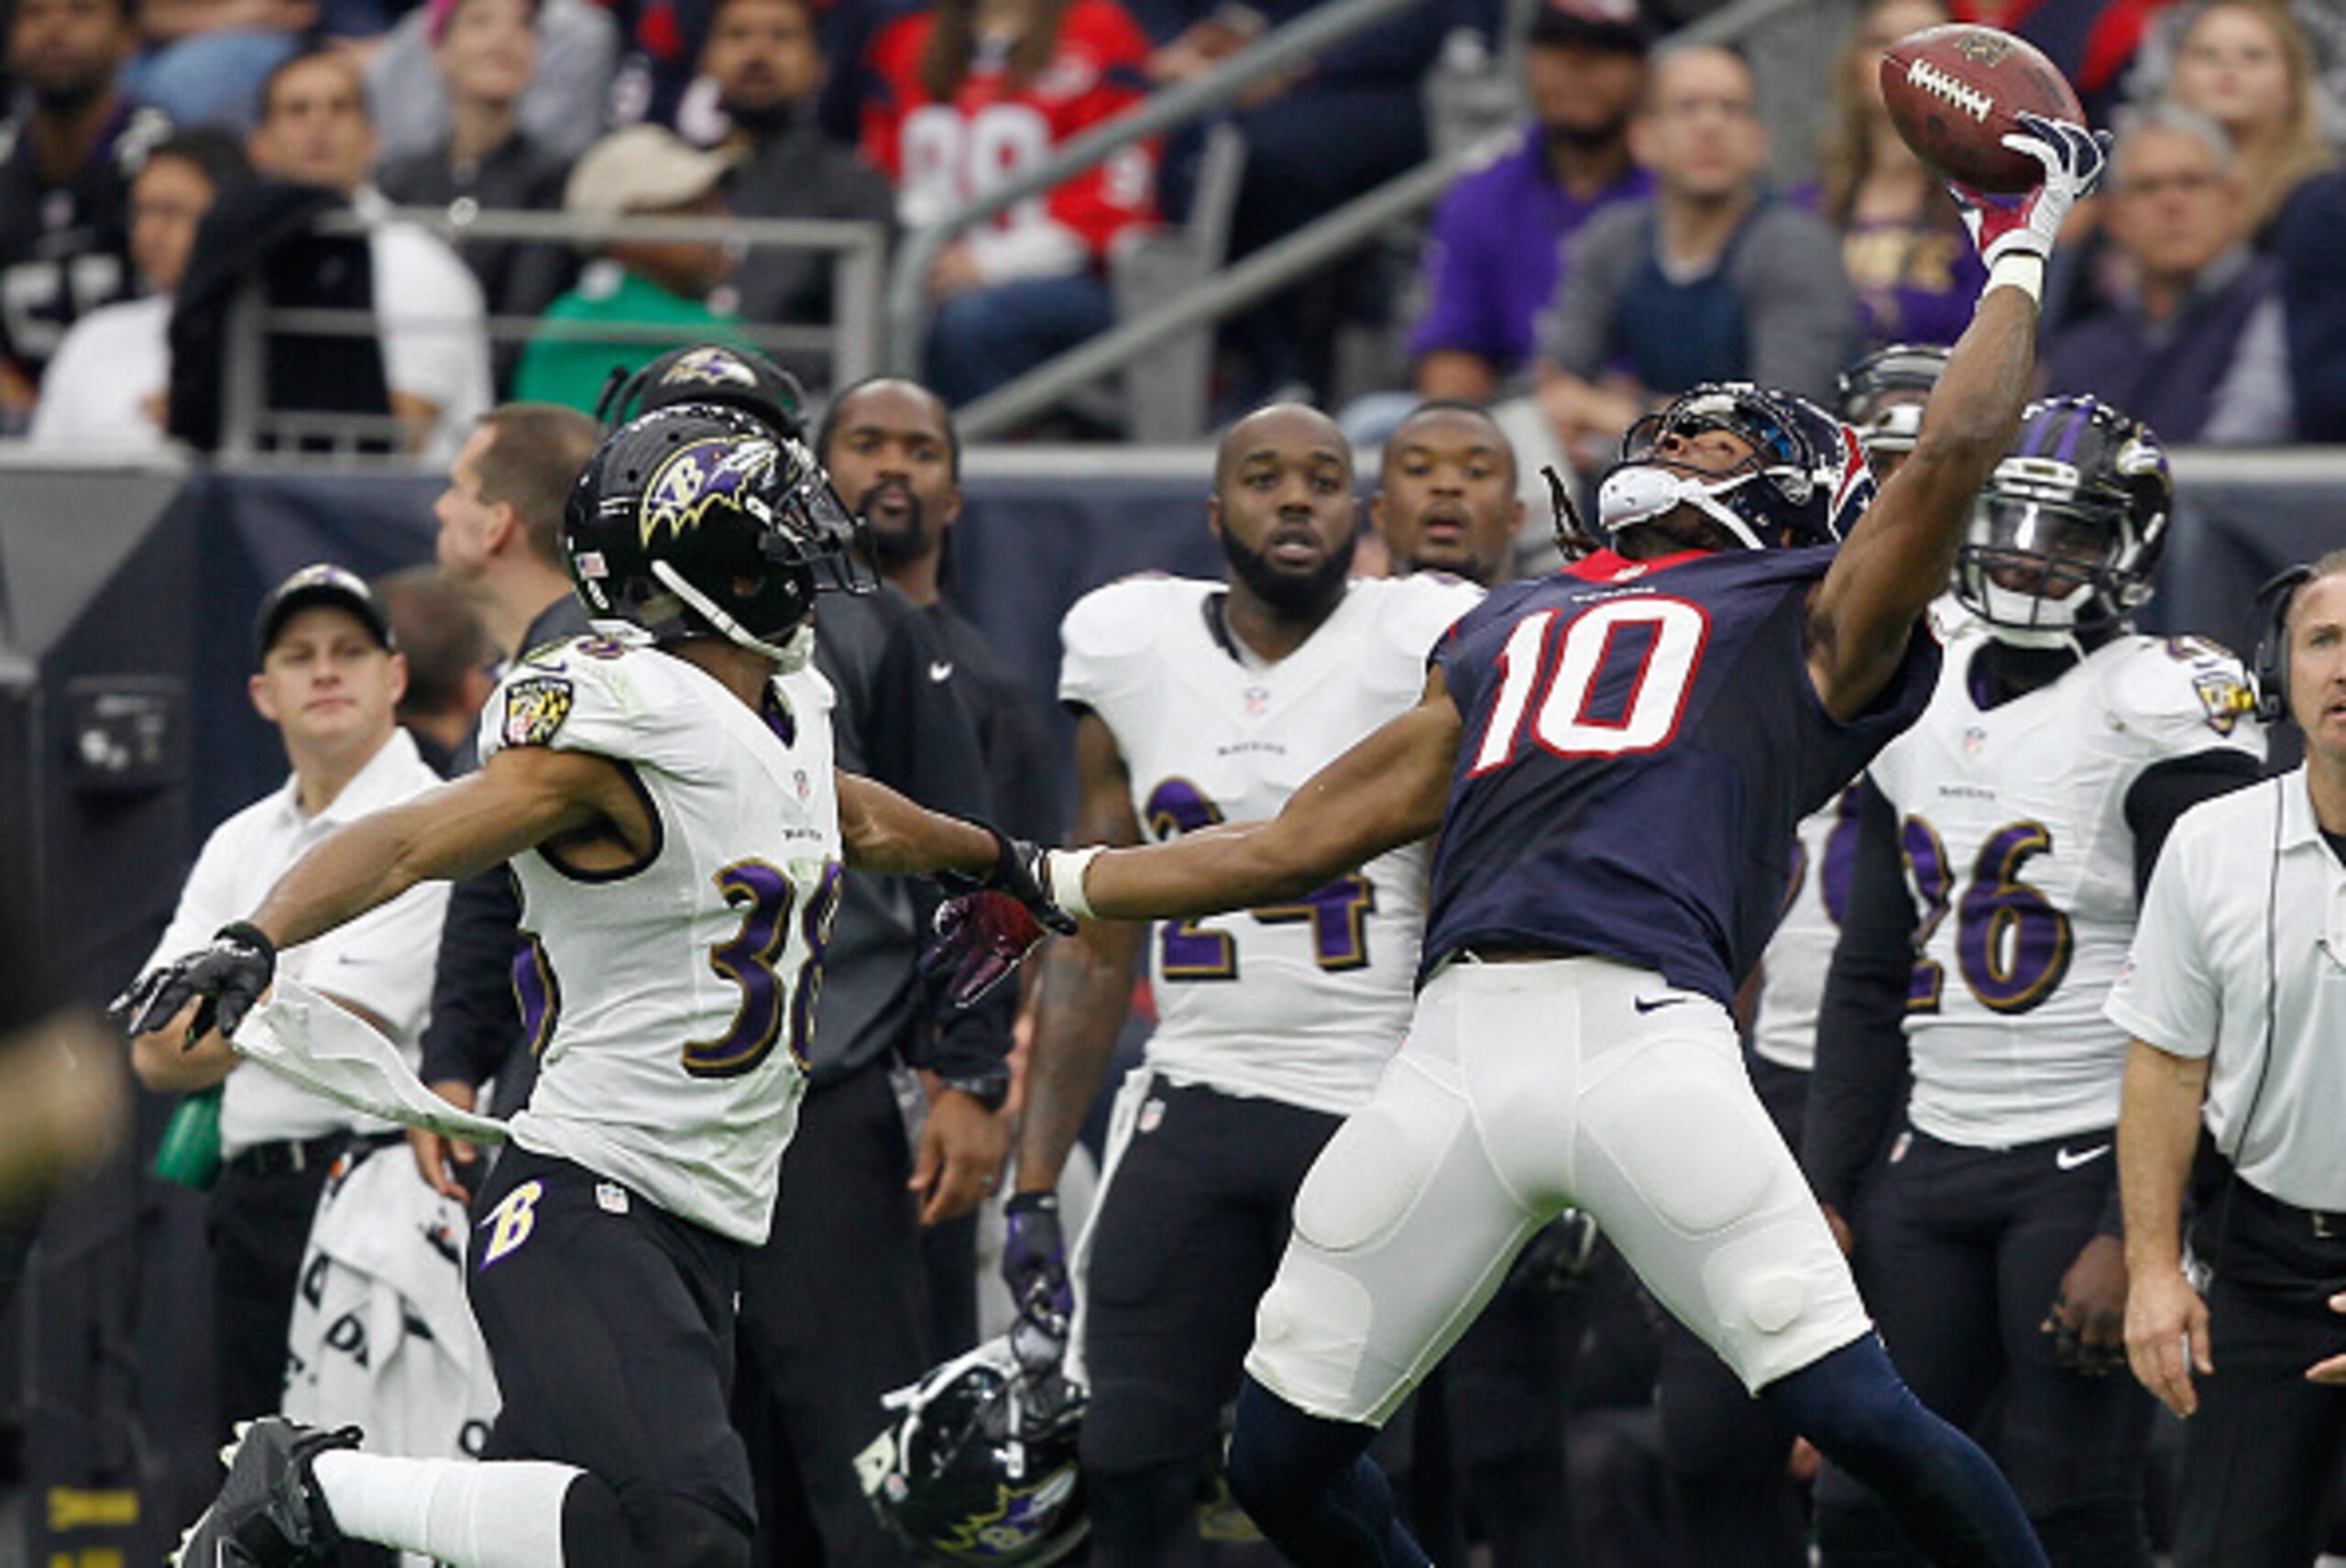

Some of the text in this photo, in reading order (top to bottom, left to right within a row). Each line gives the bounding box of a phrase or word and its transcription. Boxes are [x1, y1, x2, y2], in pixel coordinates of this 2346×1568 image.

[1466, 595, 1712, 777] 10
[681, 855, 844, 1080] 38
[1893, 814, 2074, 1015] 26
[477, 1179, 547, 1271] B
